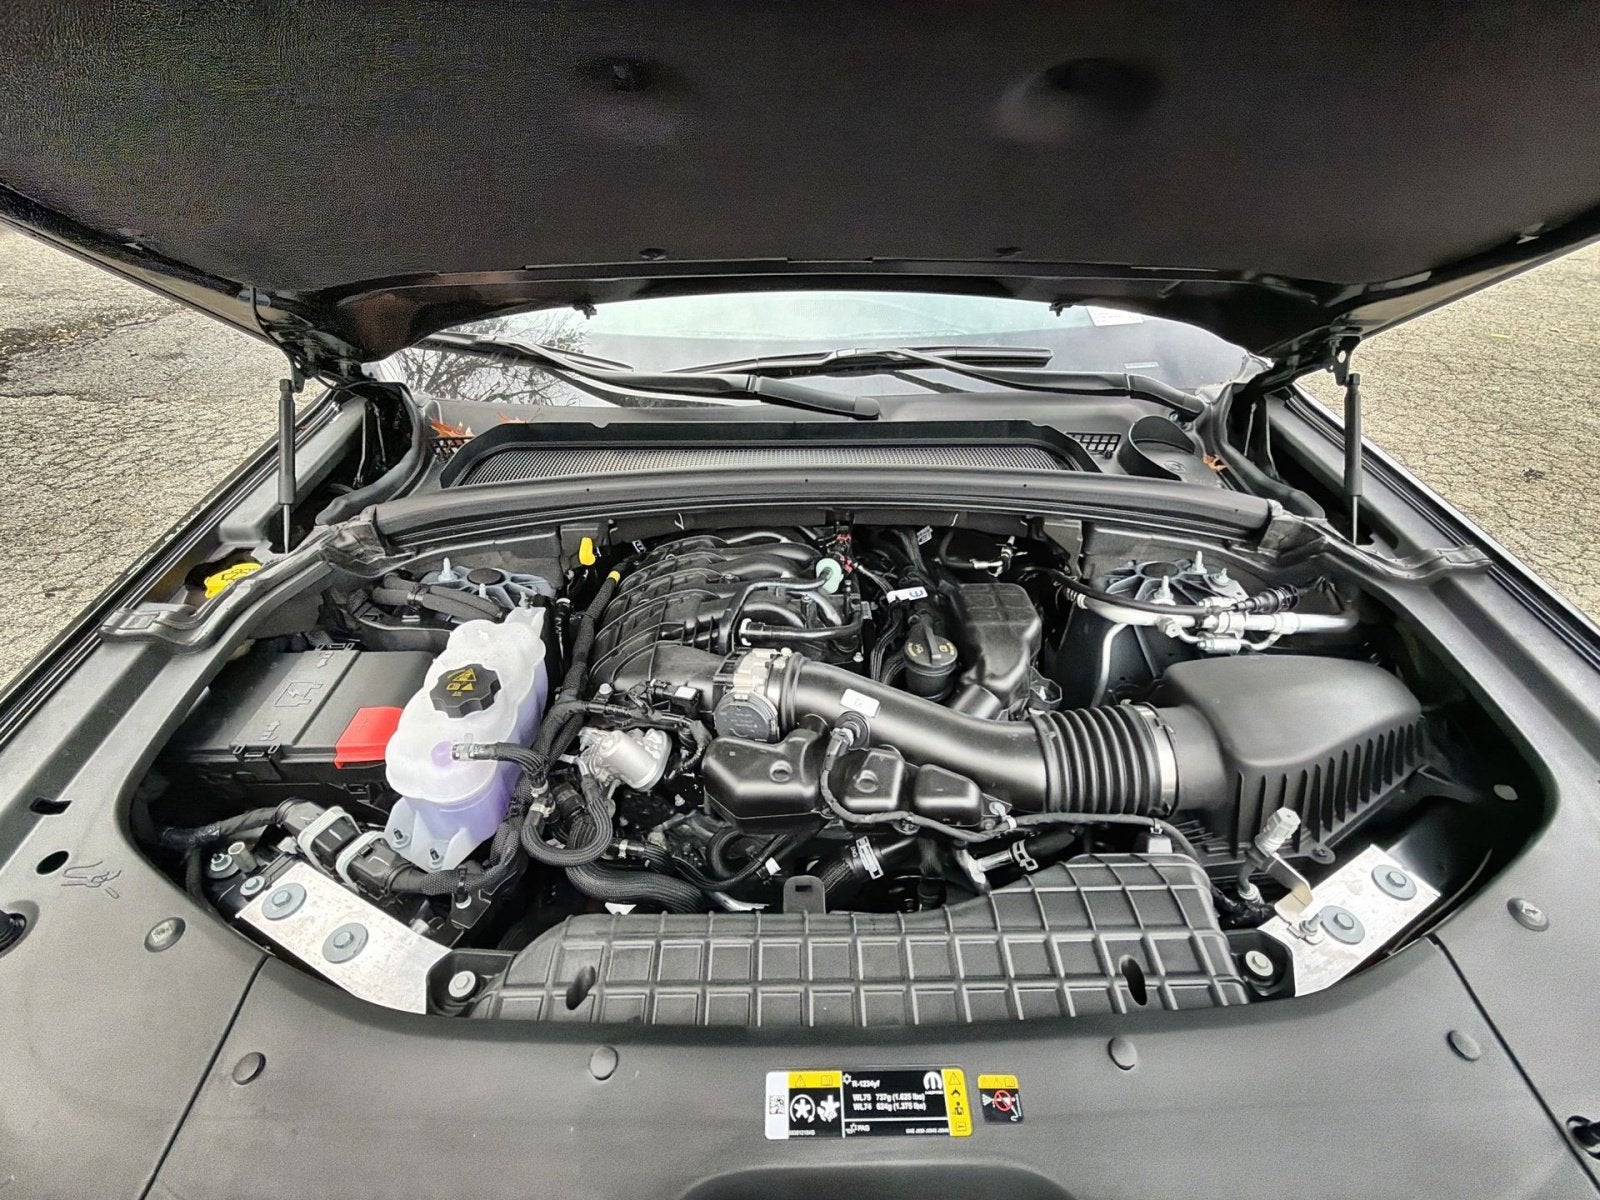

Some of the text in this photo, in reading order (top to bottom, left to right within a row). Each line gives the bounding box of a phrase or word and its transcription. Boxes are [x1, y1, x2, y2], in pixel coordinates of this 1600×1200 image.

[852, 1080, 880, 1089] R-1234yf
[852, 1093, 925, 1102] WL75 737g (1.625 lbs)
[852, 1102, 926, 1112] WL74 624g (1.375 lbs)
